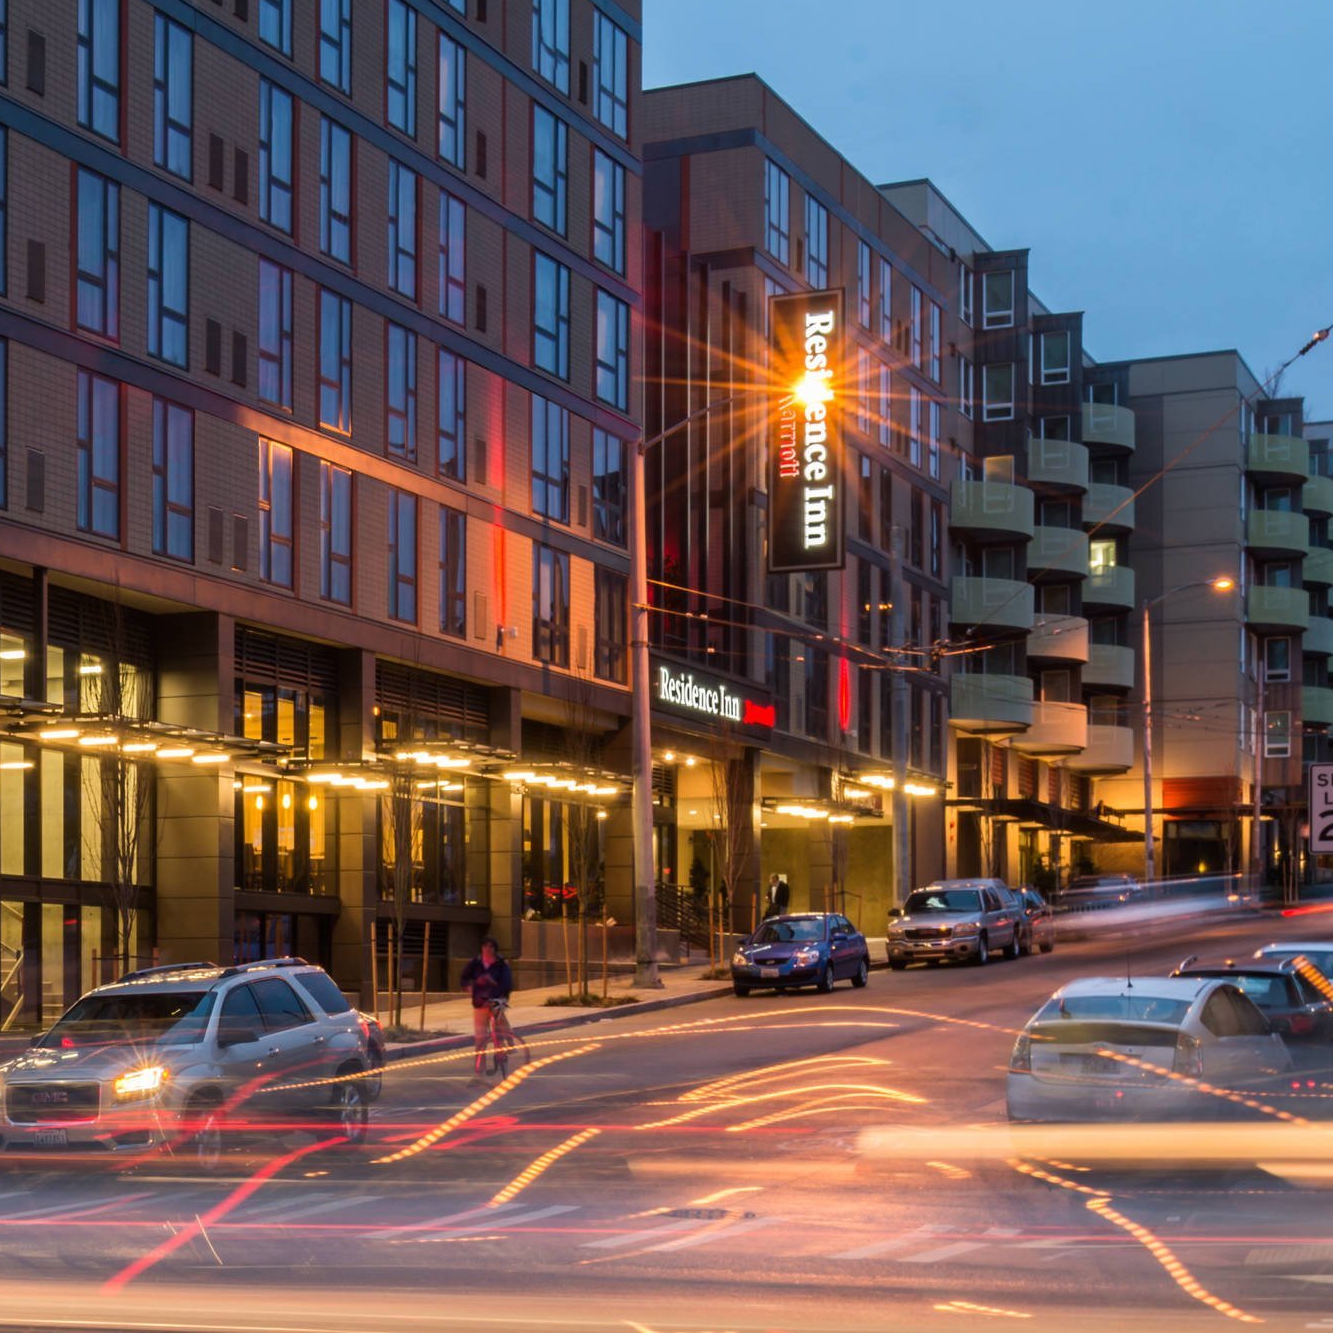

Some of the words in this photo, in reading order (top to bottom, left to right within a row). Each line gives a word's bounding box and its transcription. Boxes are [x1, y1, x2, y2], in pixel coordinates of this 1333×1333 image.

[804, 484, 834, 550] Inn
[659, 665, 719, 715] Residence
[719, 684, 741, 721] Inn
